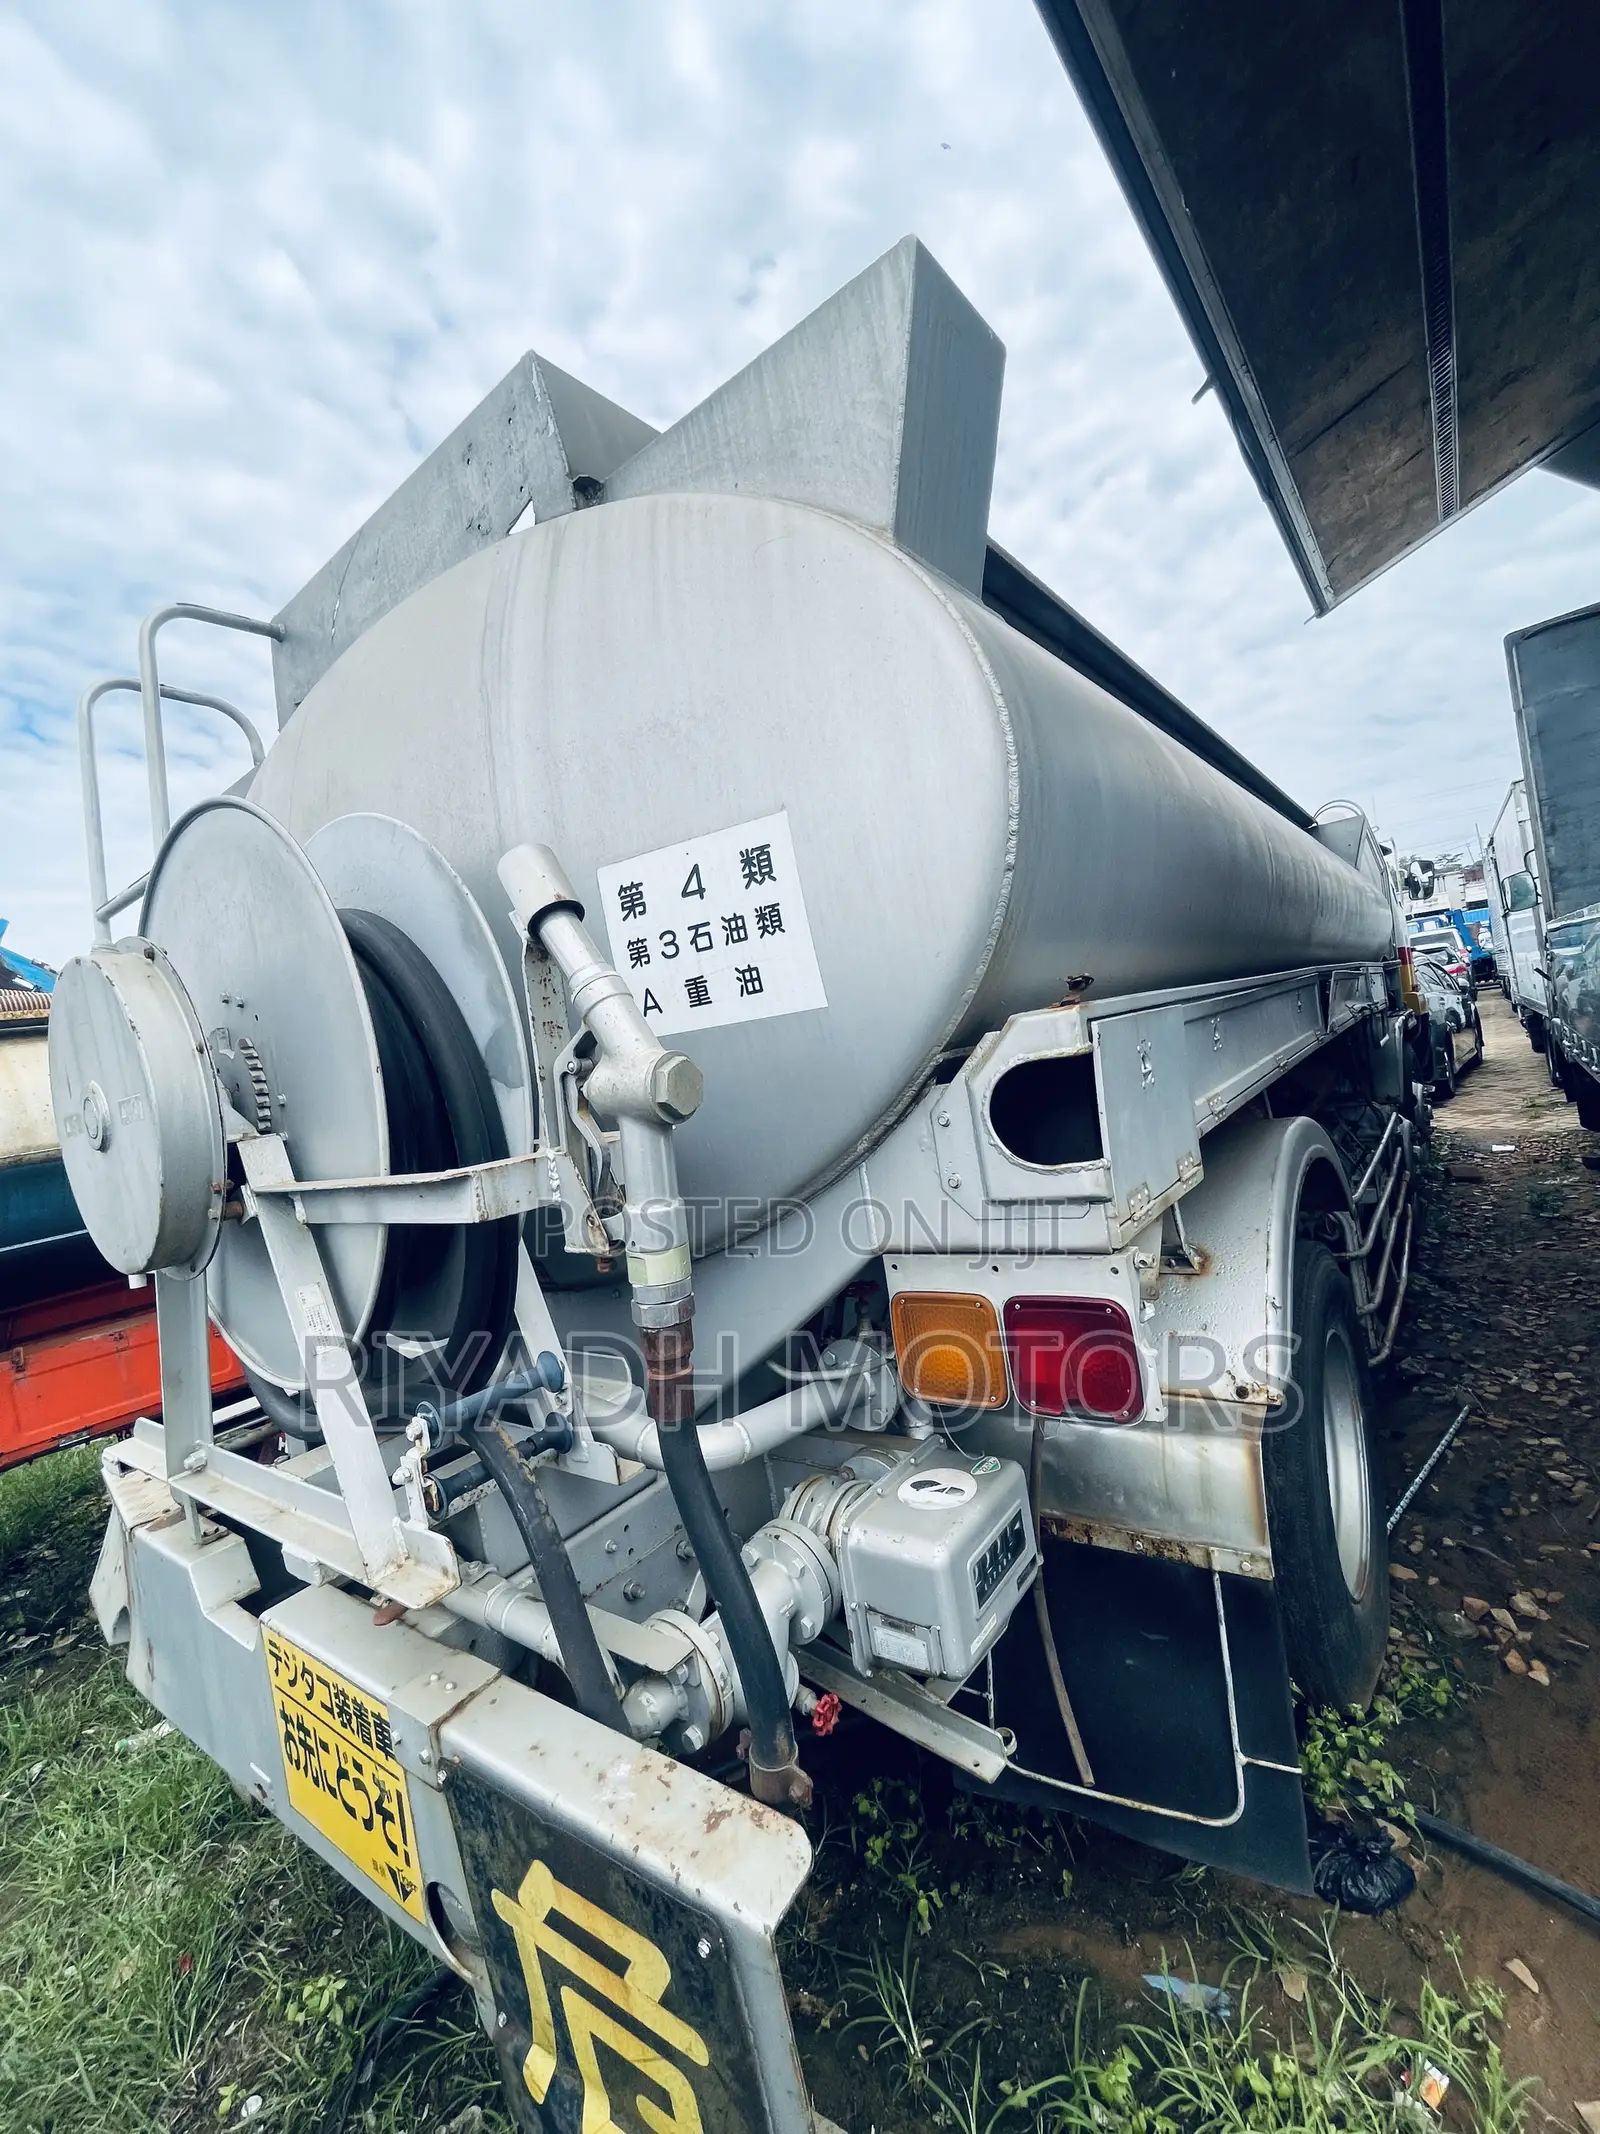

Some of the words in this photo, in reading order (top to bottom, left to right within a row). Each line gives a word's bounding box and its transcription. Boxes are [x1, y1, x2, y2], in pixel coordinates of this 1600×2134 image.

[626, 902, 786, 969] 第3石油類
[268, 1638, 396, 1762] デジタコ装着車
